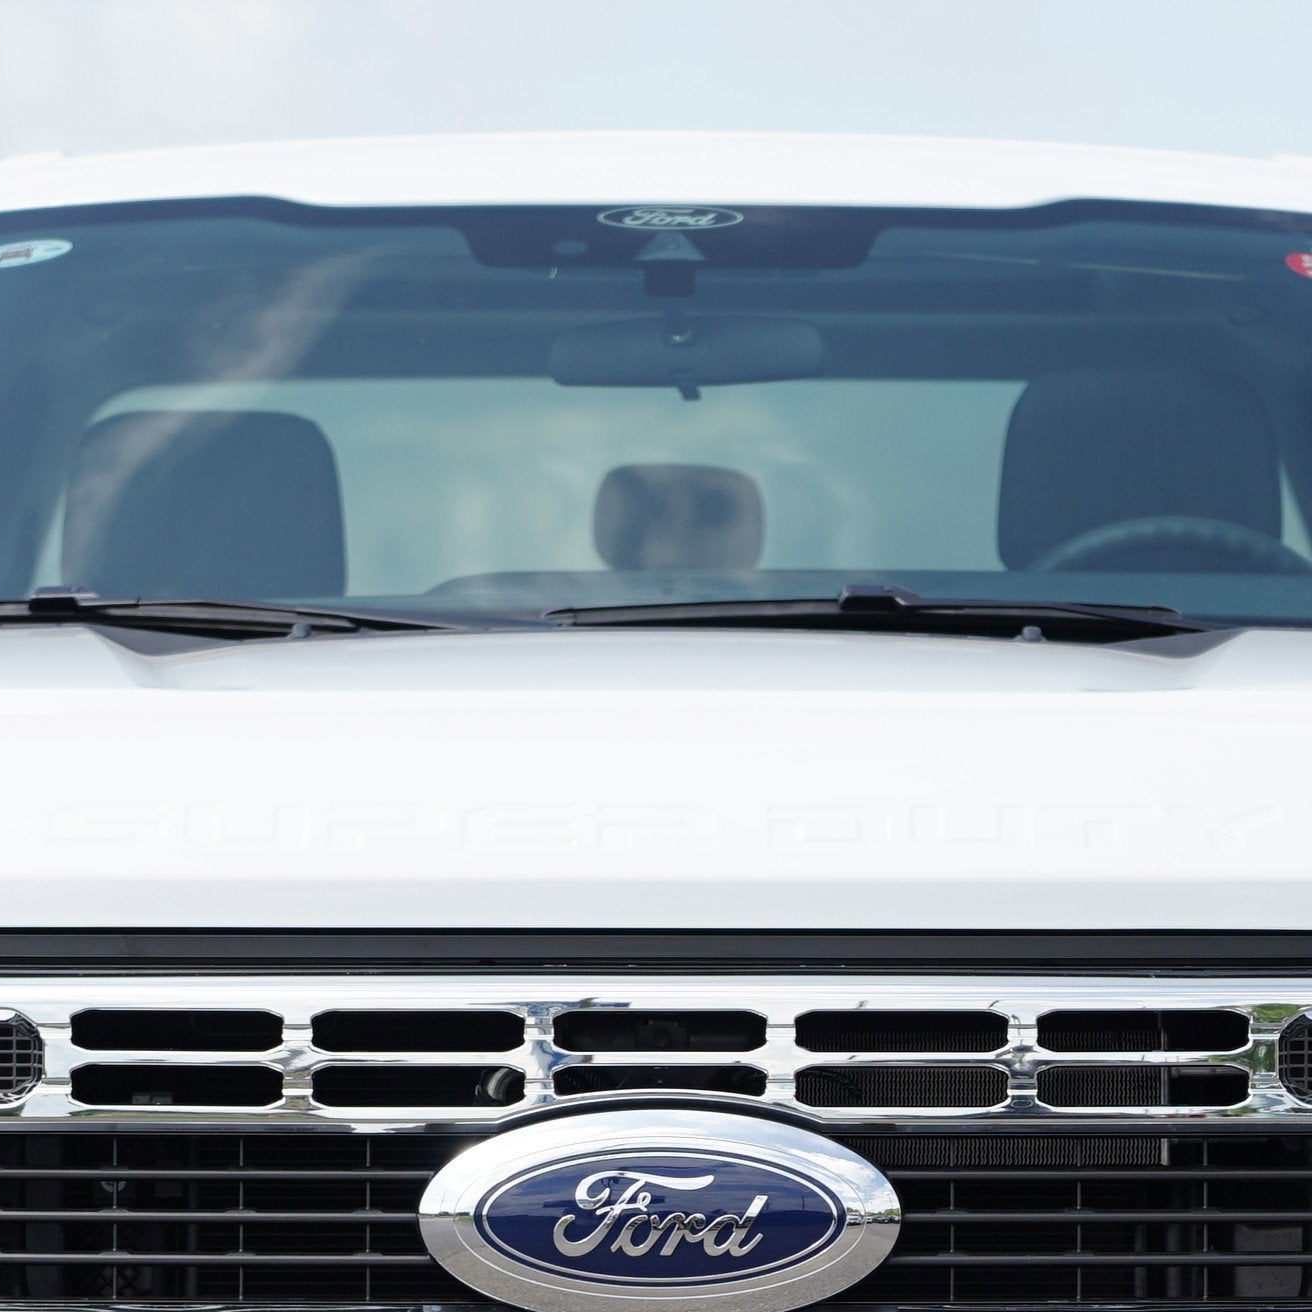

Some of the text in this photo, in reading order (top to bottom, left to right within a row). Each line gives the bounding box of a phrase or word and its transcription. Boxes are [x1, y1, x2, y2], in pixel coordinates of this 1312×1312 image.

[622, 209, 718, 226] Ford
[45, 801, 1284, 851] SUPER DUTY
[553, 1171, 768, 1258] Ford
